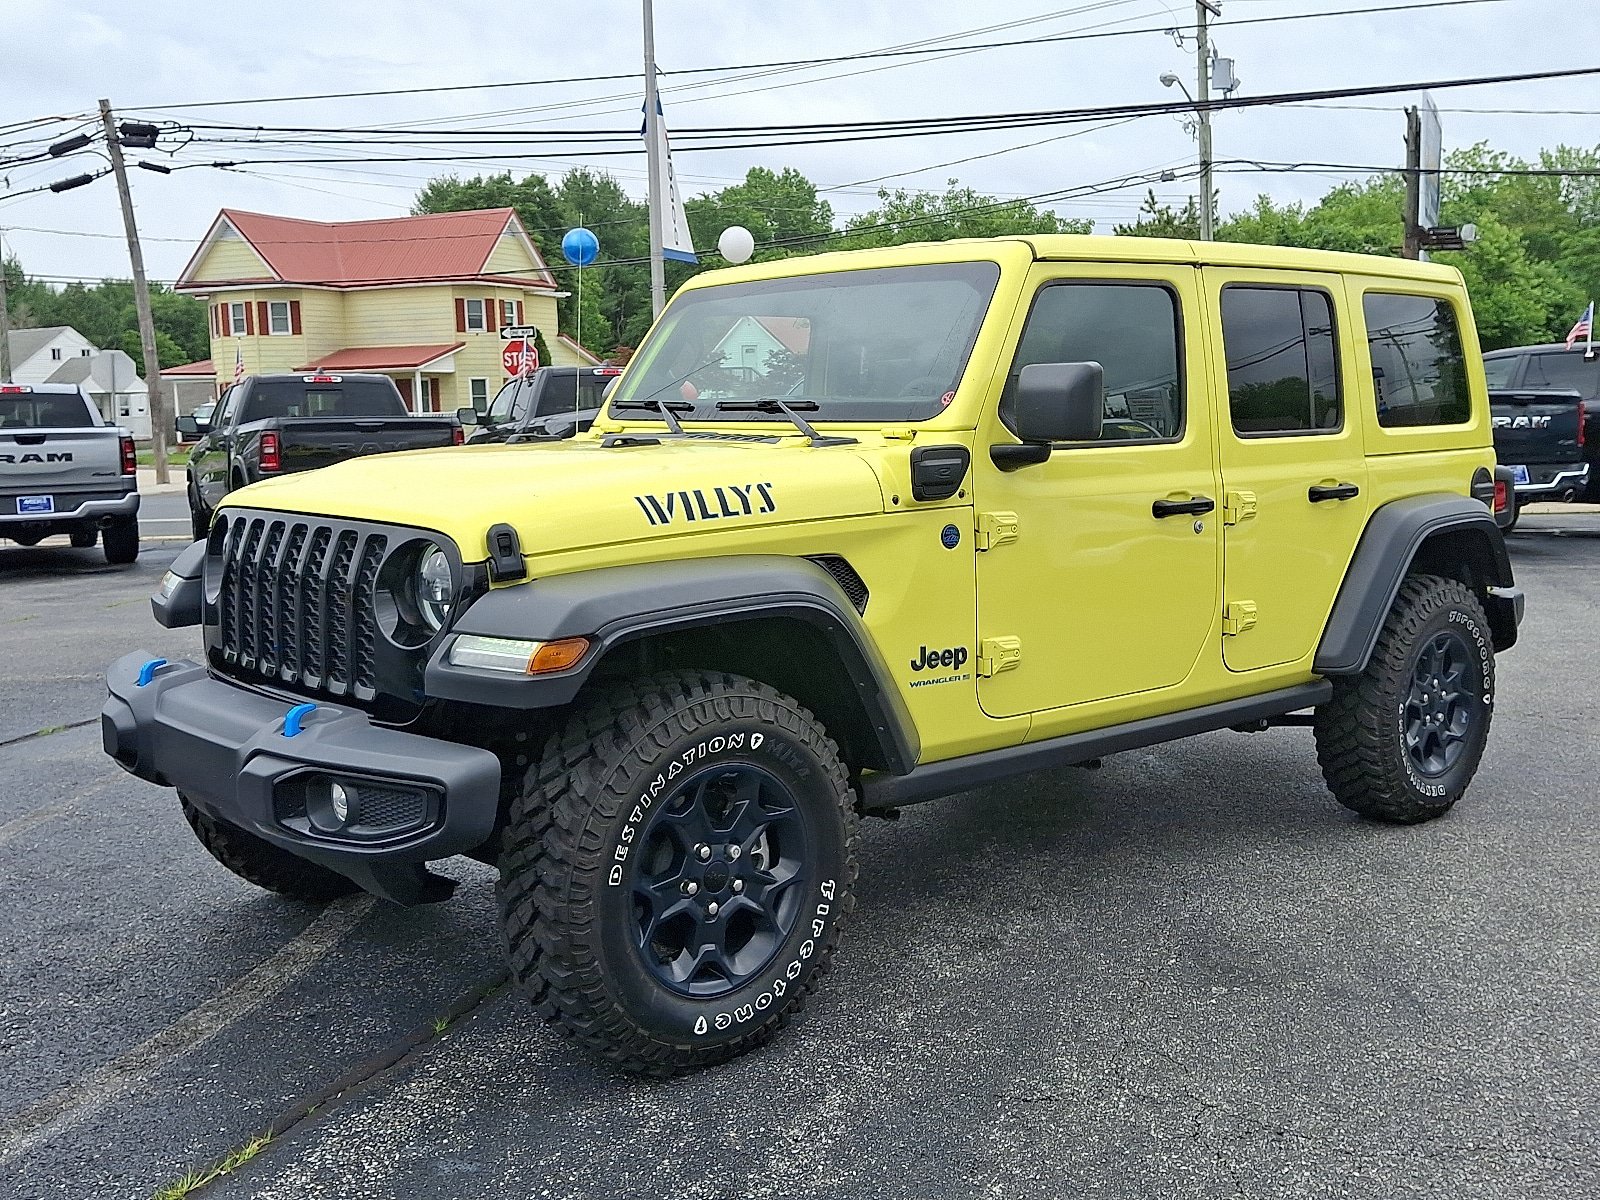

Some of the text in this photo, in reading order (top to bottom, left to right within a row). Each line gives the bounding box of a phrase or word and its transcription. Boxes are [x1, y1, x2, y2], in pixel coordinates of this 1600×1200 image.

[1492, 415, 1552, 429] RAM
[0, 453, 73, 464] RAM
[634, 482, 775, 526] WILLYS
[910, 646, 968, 671] Jeep
[909, 675, 961, 688] WRANGLER
[609, 733, 745, 886] DESTINATION
